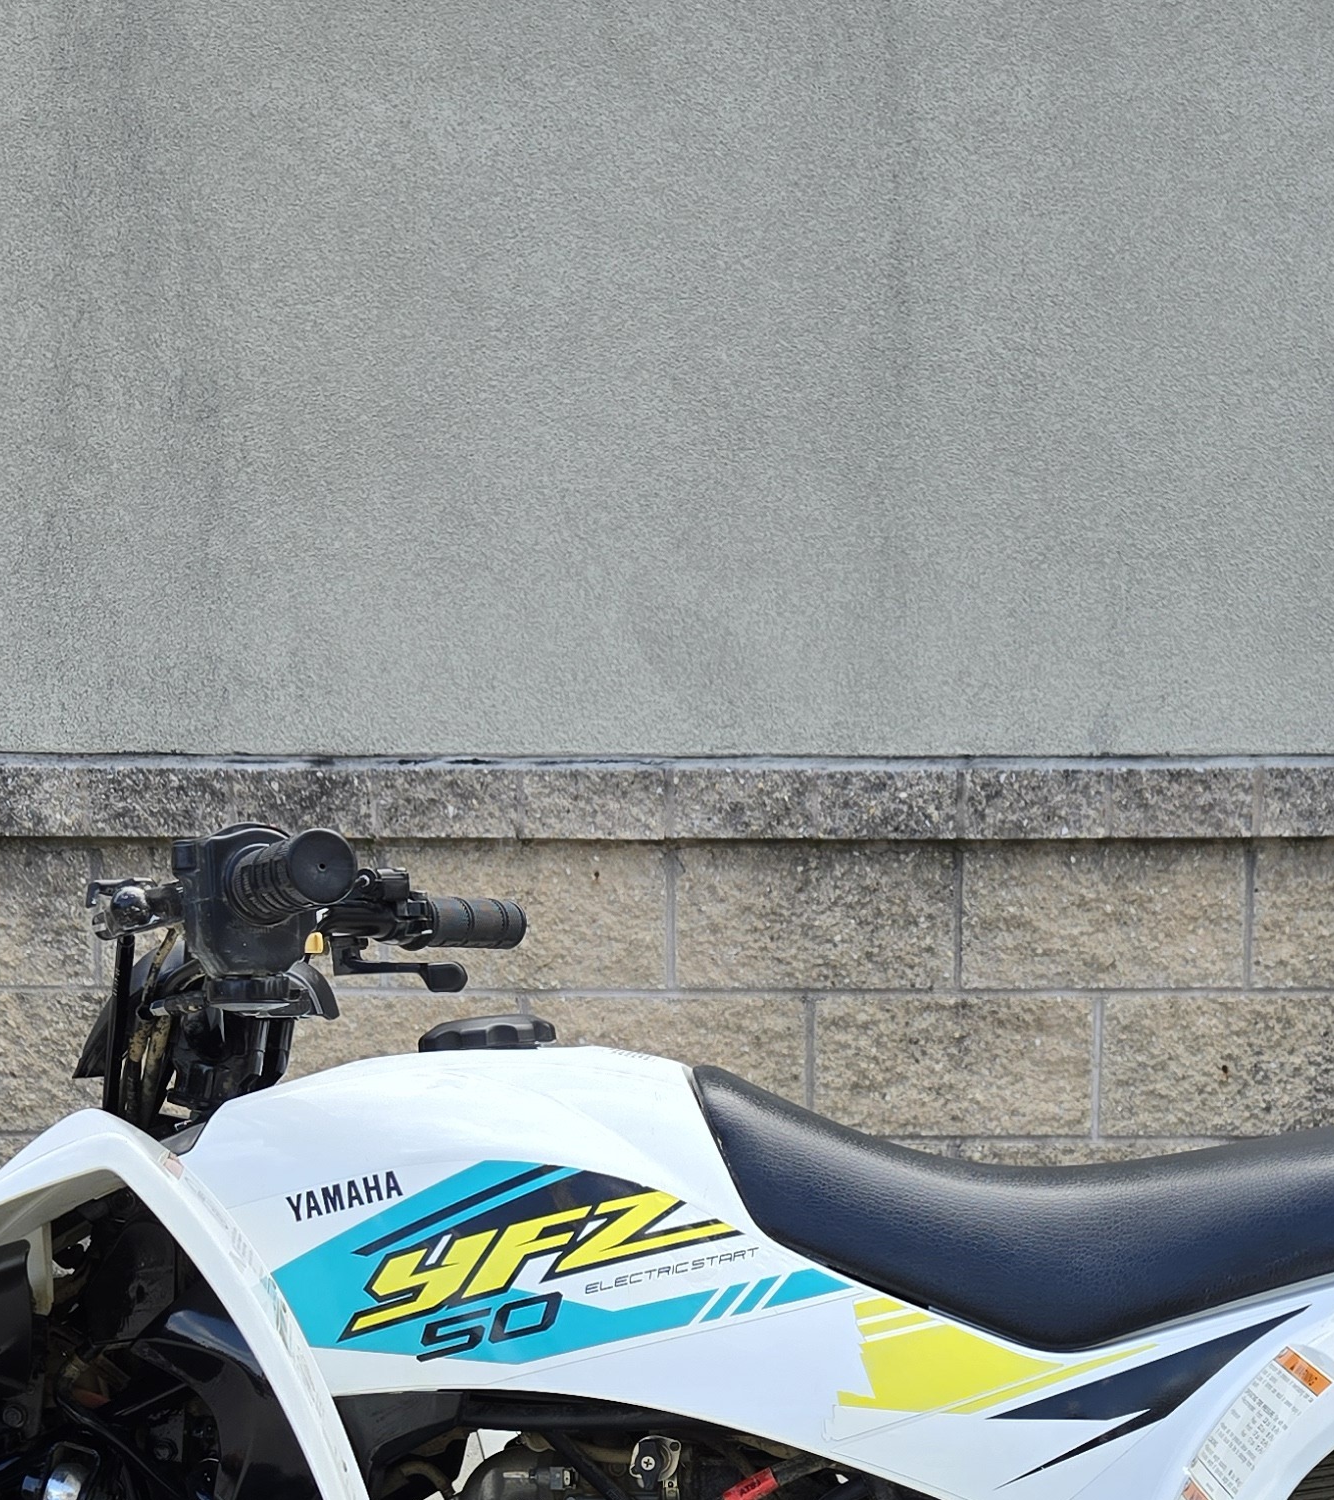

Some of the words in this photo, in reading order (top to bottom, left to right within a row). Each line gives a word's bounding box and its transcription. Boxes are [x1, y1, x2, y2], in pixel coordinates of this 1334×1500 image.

[286, 1171, 403, 1222] YAMAHA
[584, 1263, 687, 1295] ELECTRIC
[687, 1246, 760, 1274] START
[416, 1291, 564, 1362] 50
